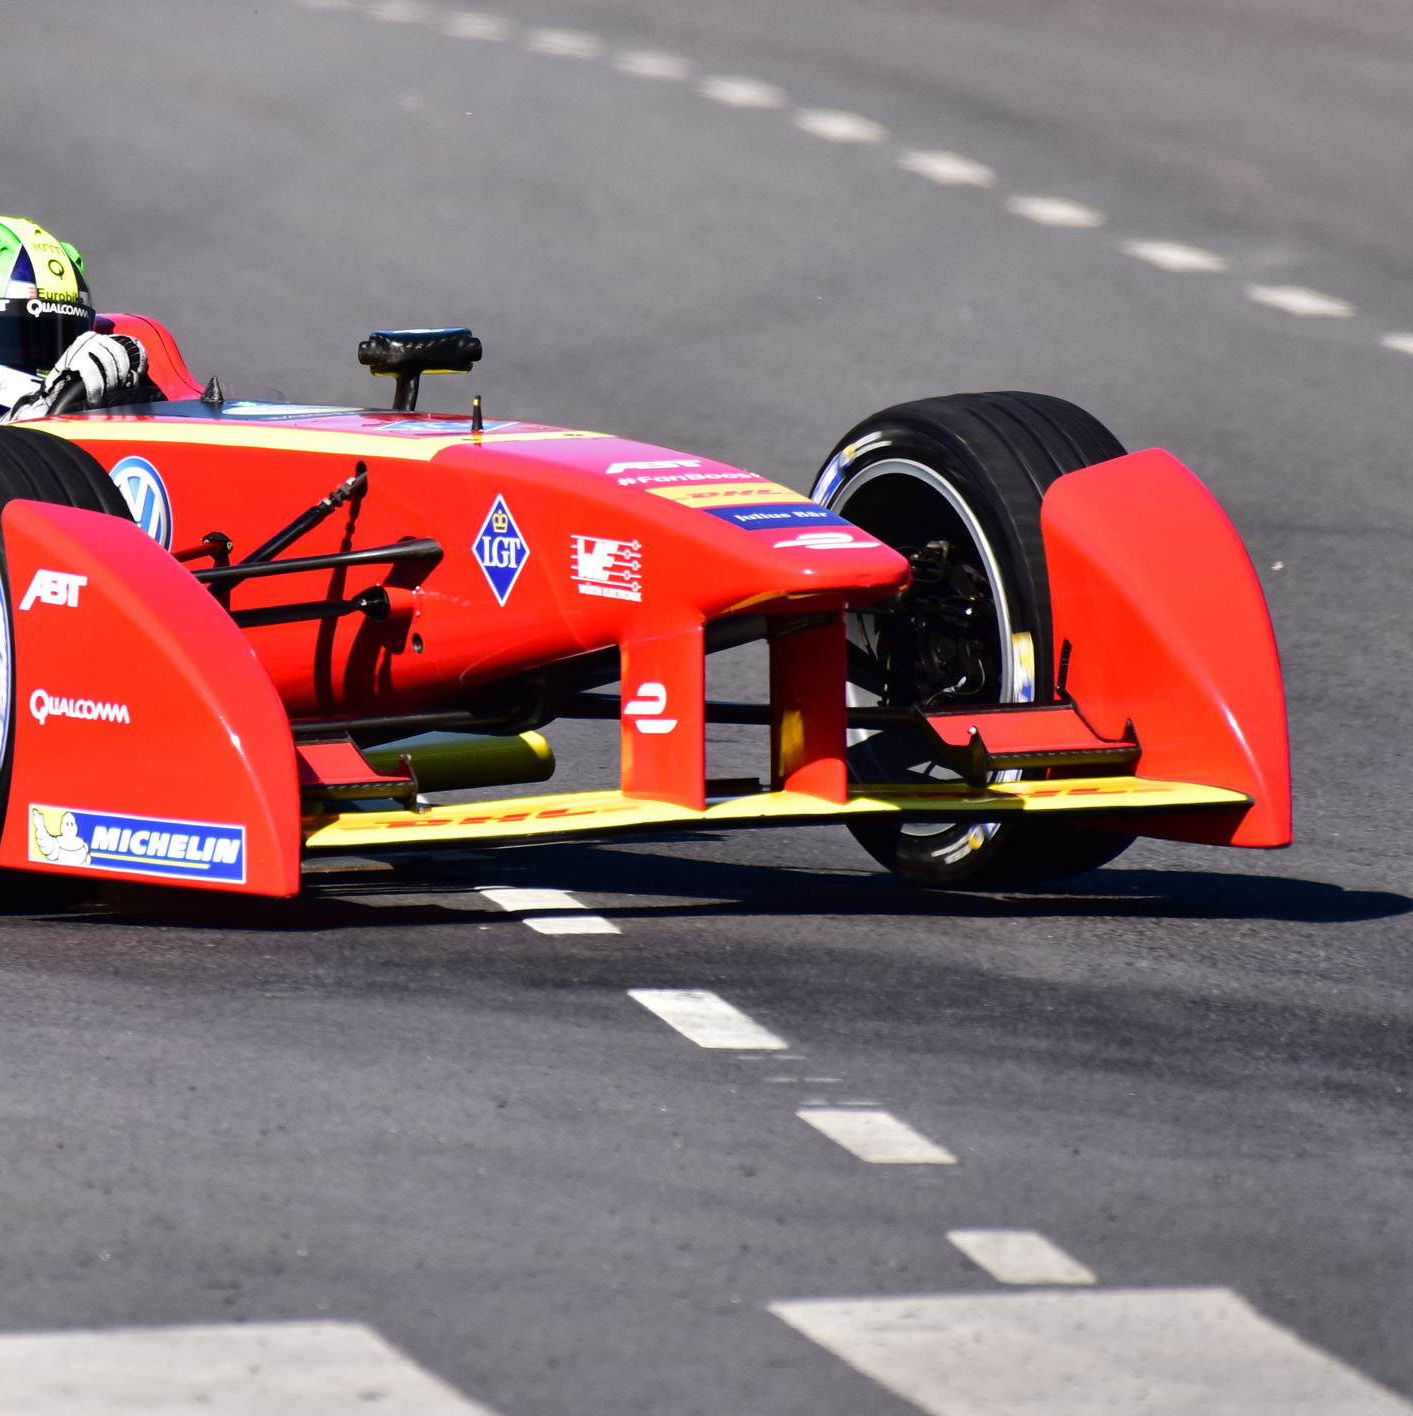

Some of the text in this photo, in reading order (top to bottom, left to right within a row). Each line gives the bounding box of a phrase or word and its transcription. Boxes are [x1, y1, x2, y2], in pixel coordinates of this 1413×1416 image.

[733, 511, 791, 522] Julius
[481, 536, 521, 569] LGT
[18, 568, 88, 611] ABT
[90, 825, 241, 865] MICHELIN
